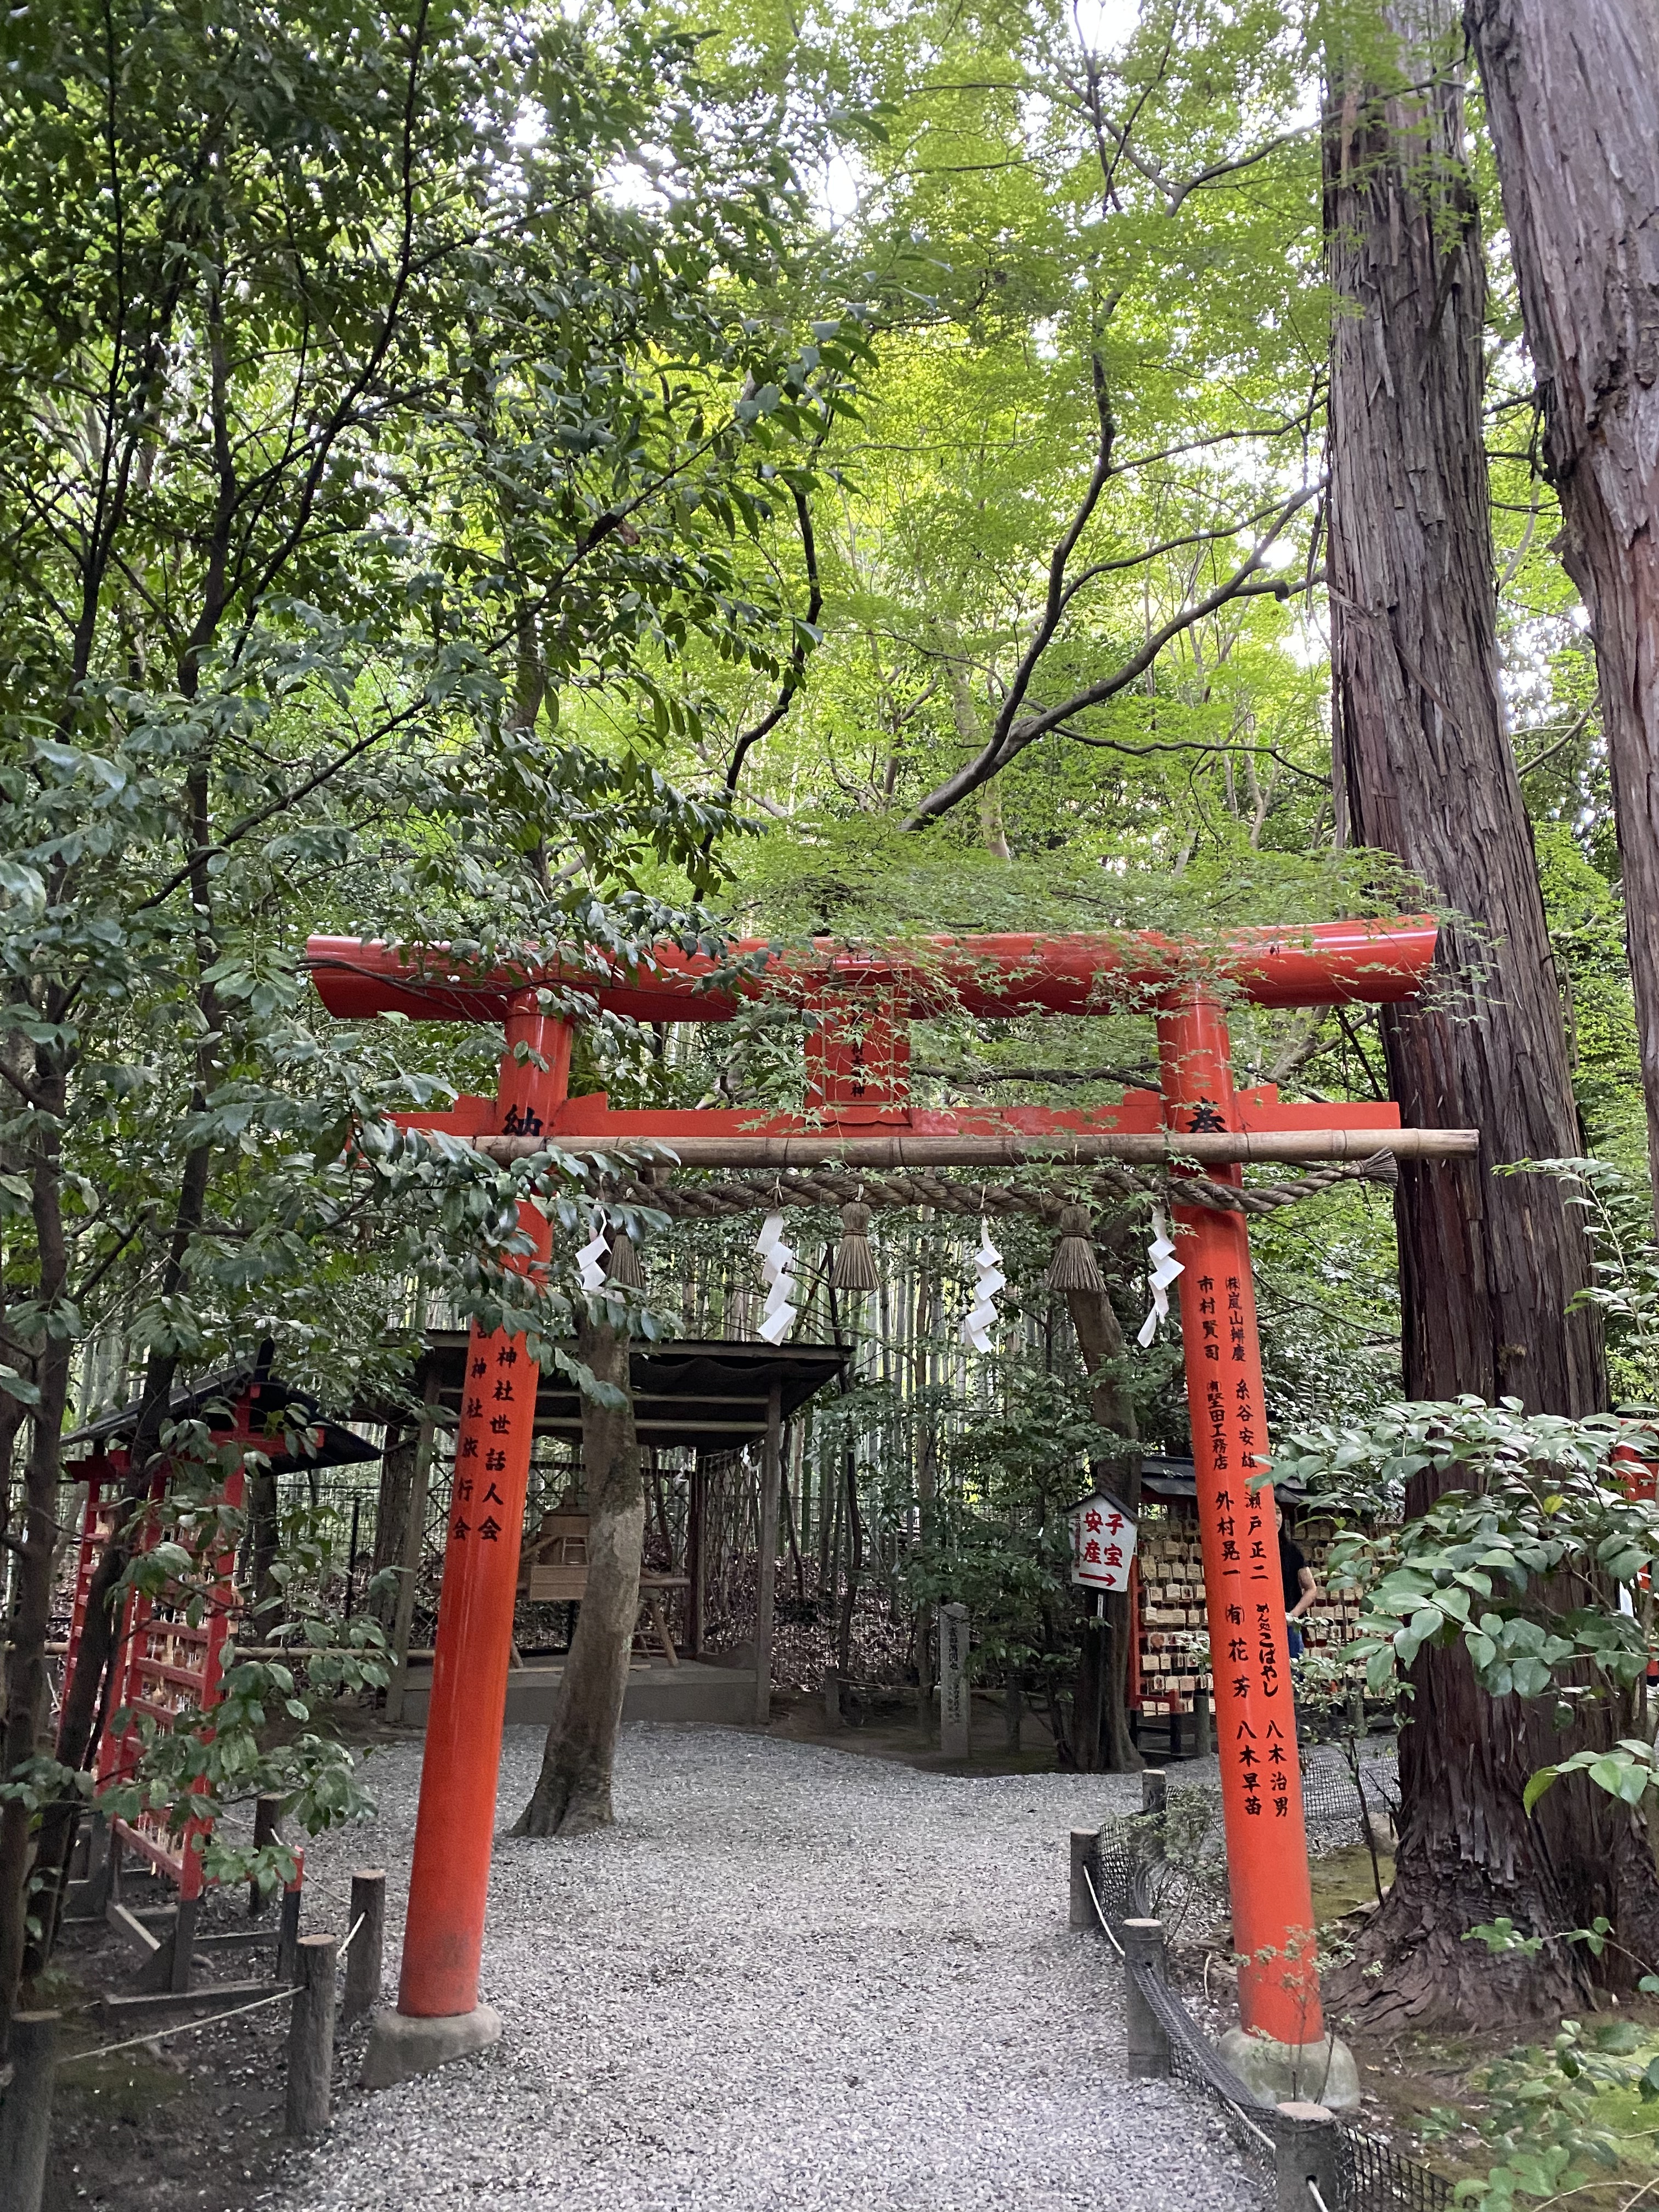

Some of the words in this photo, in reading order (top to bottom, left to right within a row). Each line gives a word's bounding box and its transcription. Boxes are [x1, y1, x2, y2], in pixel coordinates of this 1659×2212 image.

[478, 1323, 517, 1542] 神社世話人会
[1235, 1378, 1257, 1469] 糸谷安雄
[1083, 1508, 1104, 1564] 安産
[1104, 1514, 1124, 1568] 子宝
[1197, 1276, 1220, 1361] 市村賢司
[1215, 1490, 1240, 1576] 外村晃一
[1236, 1720, 1262, 1815] 八木早苗
[1244, 1491, 1269, 1579] 瀬戸正二
[1266, 1720, 1288, 1817] 八木治男
